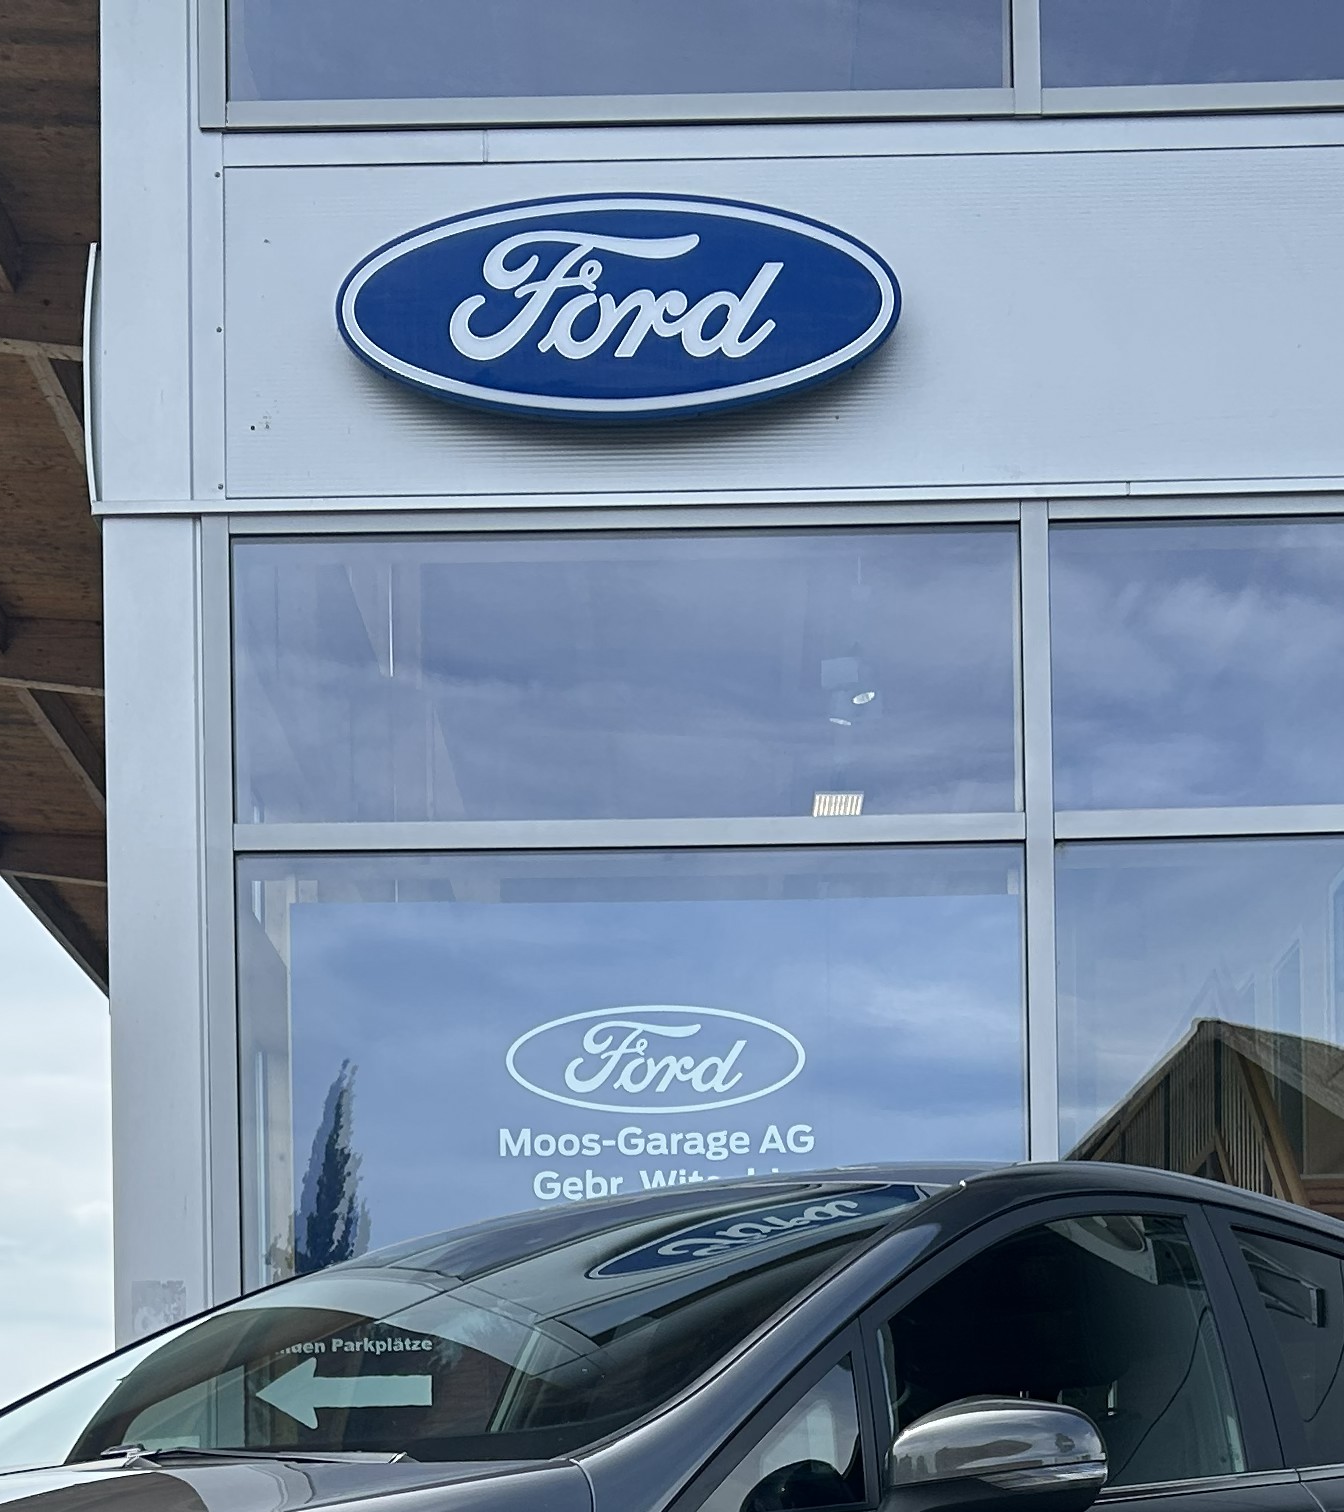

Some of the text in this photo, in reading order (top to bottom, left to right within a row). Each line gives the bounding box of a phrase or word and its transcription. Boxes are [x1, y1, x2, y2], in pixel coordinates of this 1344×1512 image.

[449, 230, 784, 360] Ford
[564, 1019, 748, 1094] Ford
[499, 1124, 814, 1161] Moos-Garage AG
[331, 1337, 432, 1355] Parkplätze
